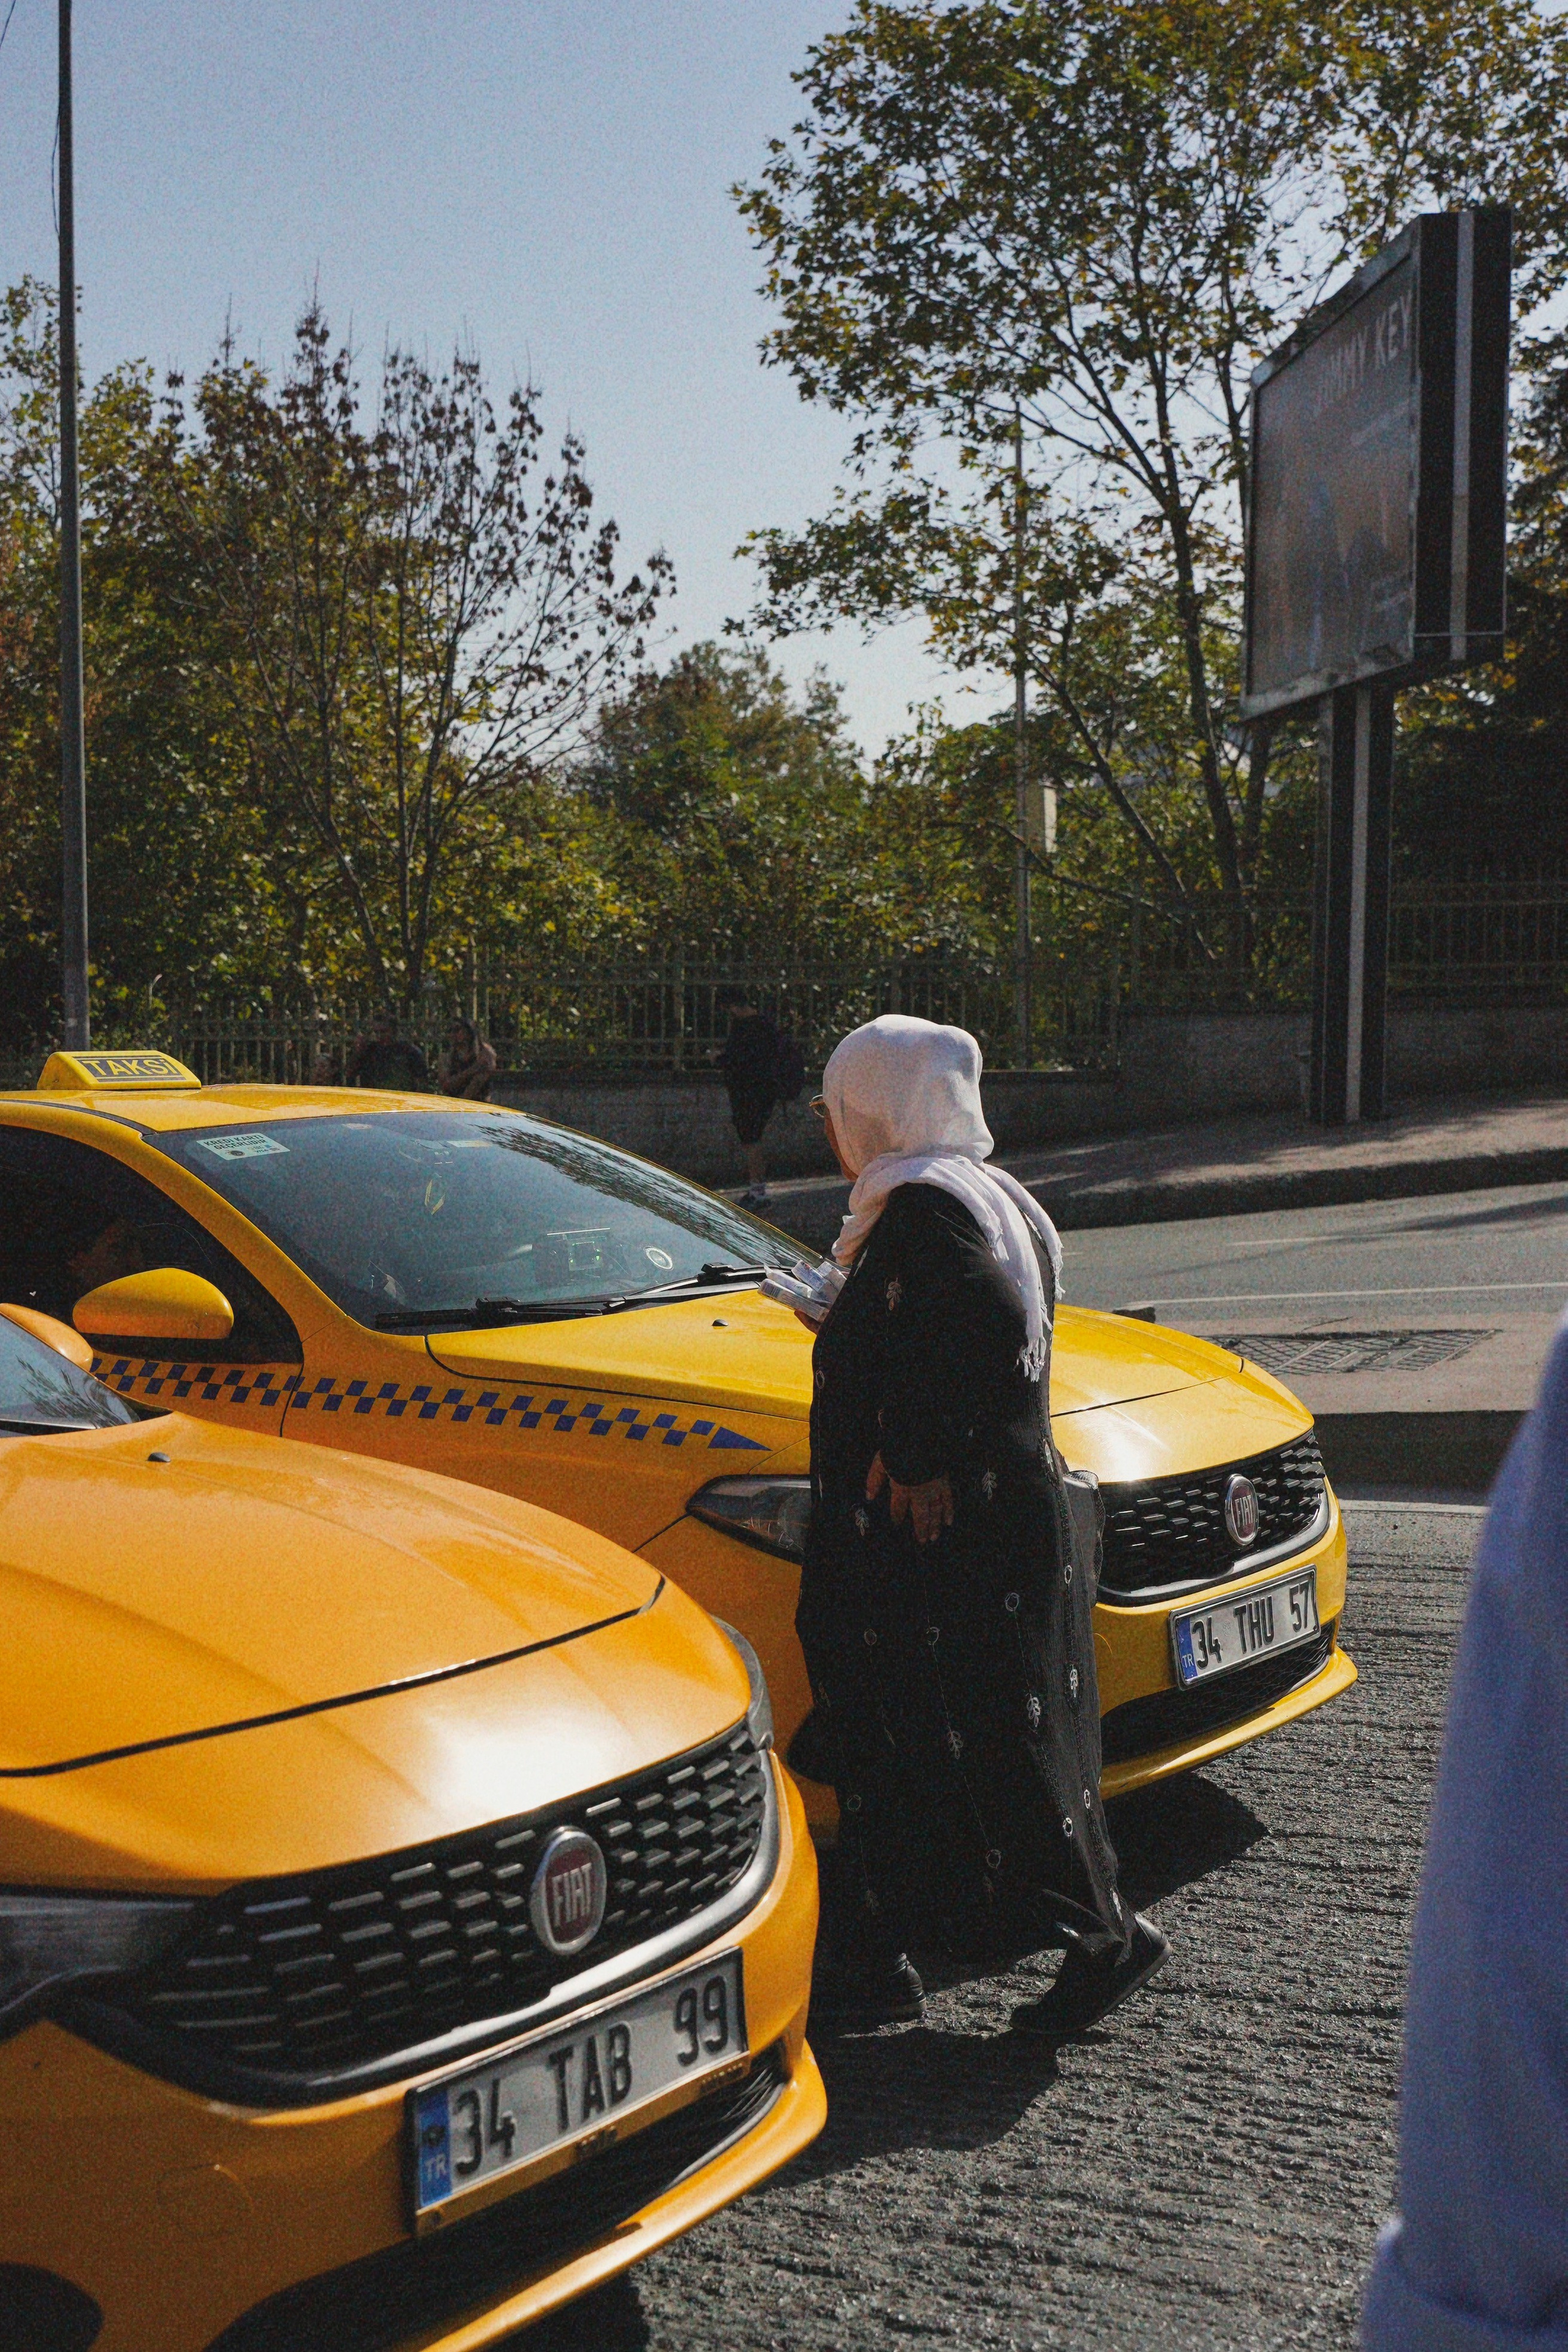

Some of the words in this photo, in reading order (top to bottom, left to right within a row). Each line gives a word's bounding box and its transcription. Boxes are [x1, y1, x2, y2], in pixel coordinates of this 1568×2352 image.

[1374, 289, 1412, 371] KEY
[1234, 1494, 1253, 1528] FIAT
[1191, 1615, 1223, 1670] 34
[1234, 1594, 1275, 1654] THU
[1289, 1580, 1310, 1633] 57
[1182, 1654, 1194, 1668] TR
[551, 1862, 592, 1928] FIAT
[452, 2078, 517, 2176] 34
[547, 2021, 632, 2134] TAB
[674, 1975, 729, 2067] 99
[424, 2153, 447, 2182] TR
